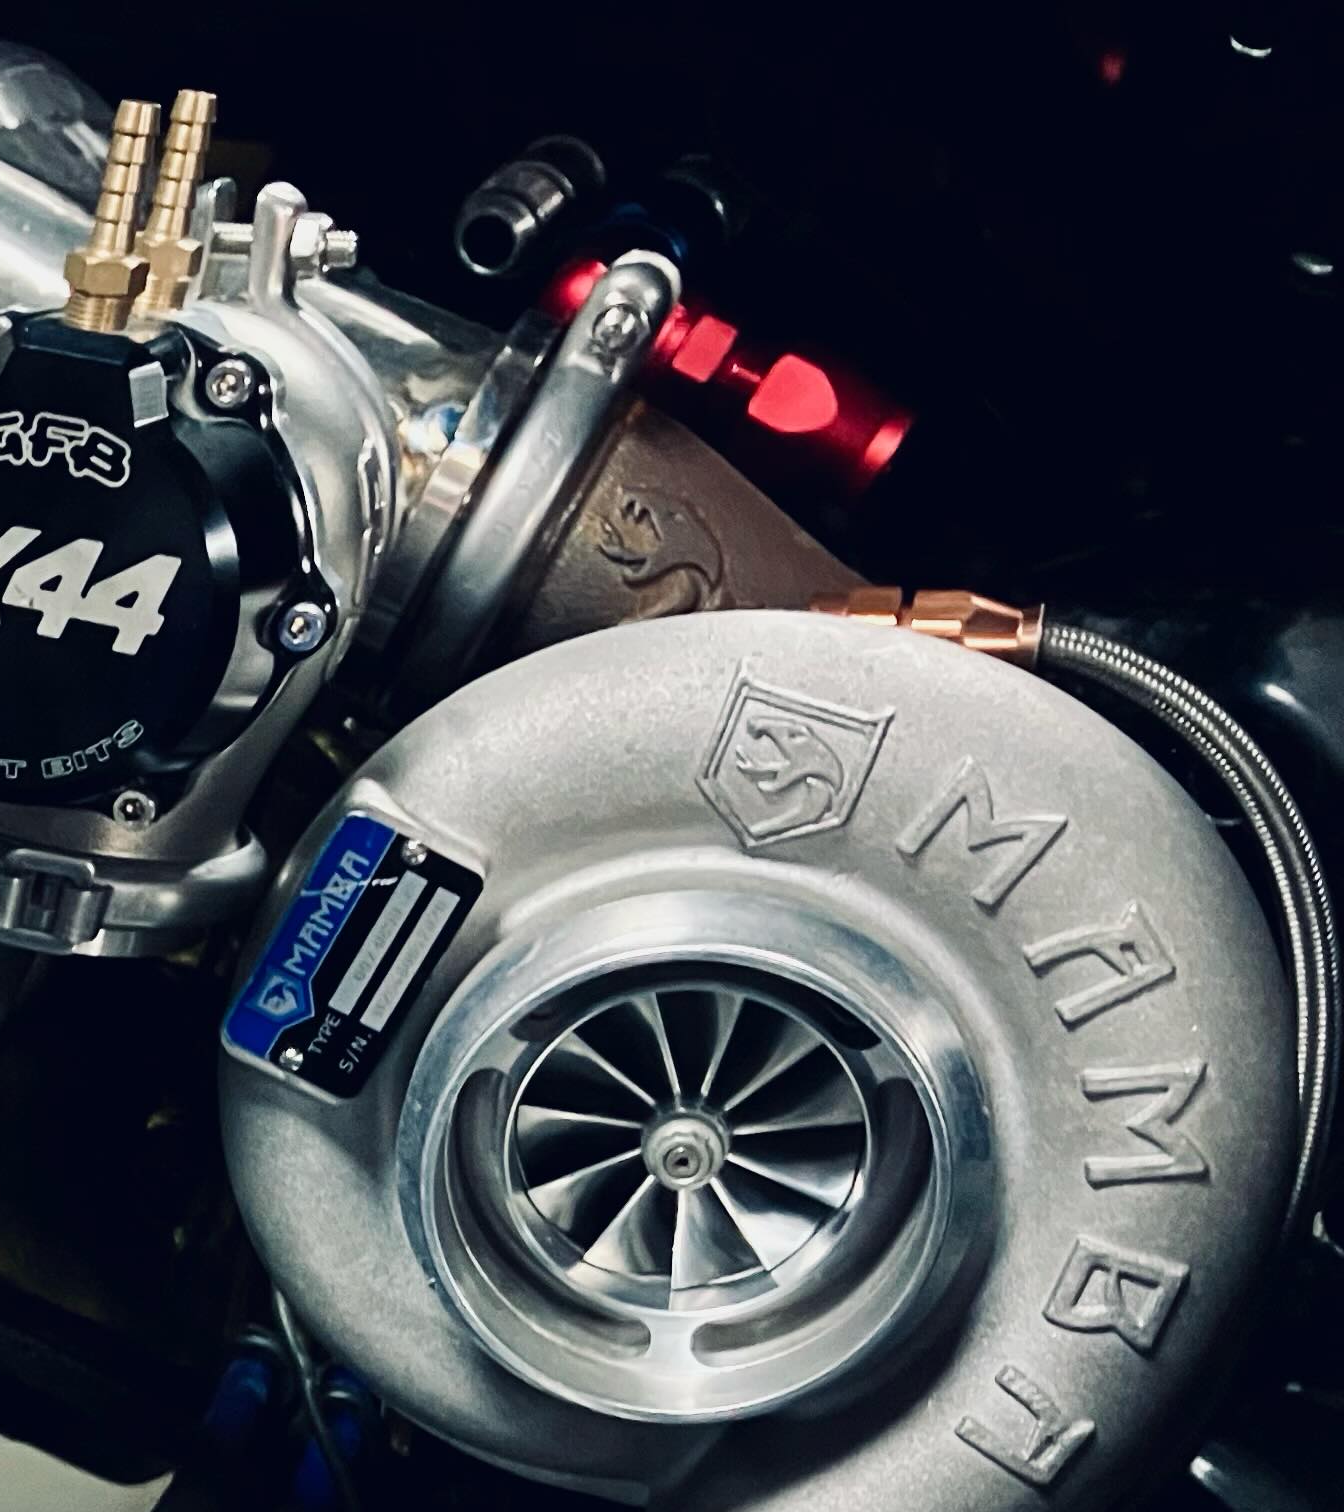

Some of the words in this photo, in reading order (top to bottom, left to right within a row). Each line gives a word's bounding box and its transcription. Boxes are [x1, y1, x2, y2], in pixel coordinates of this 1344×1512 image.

[41, 720, 145, 780] BITS
[283, 850, 370, 976] MAMBA
[308, 1013, 341, 1053] TYPE
[898, 756, 1211, 1485] MAMBA
